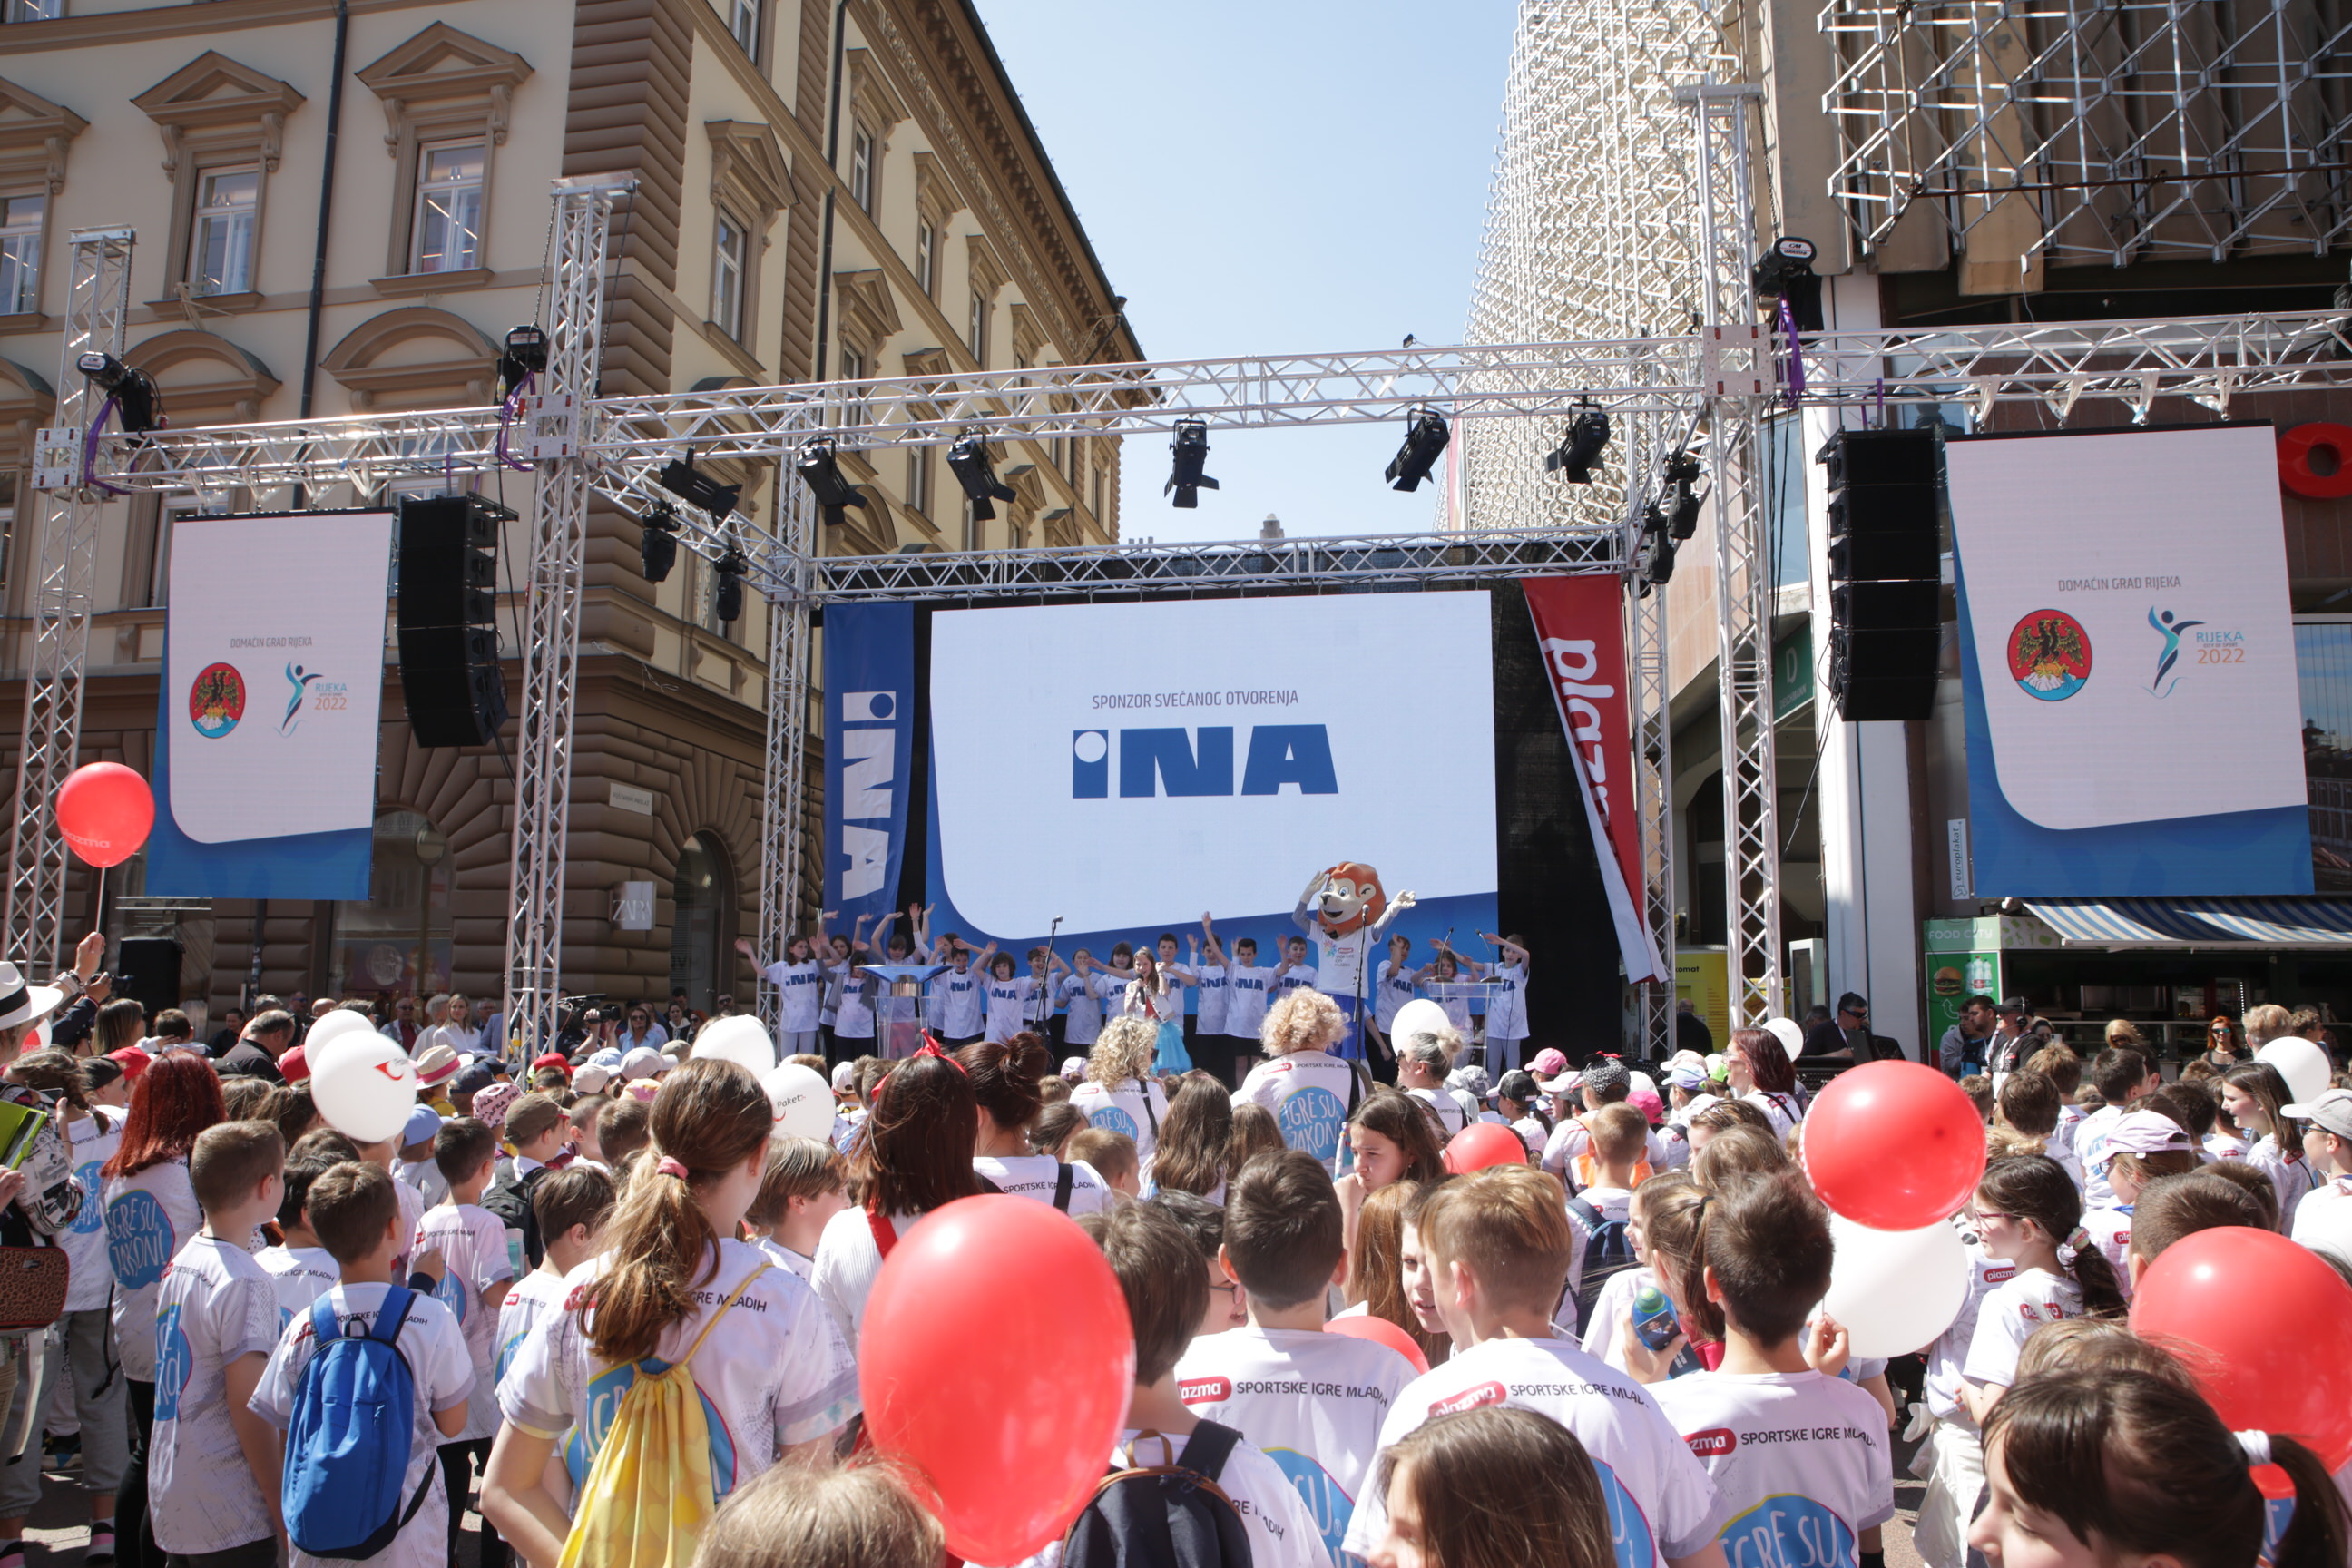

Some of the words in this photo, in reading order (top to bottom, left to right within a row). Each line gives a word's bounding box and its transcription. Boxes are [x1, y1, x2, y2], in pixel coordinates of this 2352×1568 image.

[2058, 576, 2110, 592] DOMAĆIN
[2112, 576, 2142, 591] GRAD
[2144, 575, 2181, 591] RIJEKA
[266, 637, 287, 648] GRAD
[288, 636, 313, 648] RIJEKA
[2196, 631, 2246, 643] RIJEKA
[2196, 647, 2246, 664] 2022
[315, 682, 348, 692] RIJEKA
[314, 697, 348, 710] 2022
[1092, 692, 1152, 710] SPONZOR
[1154, 687, 1222, 709] SVEČANOG
[1225, 690, 1299, 708] OTVORENJA
[1952, 827, 1963, 882] europlakat
[612, 899, 652, 922] ZARA
[1928, 929, 1961, 940] FOOD
[1283, 1092, 1317, 1131] IGRE
[1318, 1094, 1337, 1117] SU
[1003, 1182, 1046, 1193] SPORTSKE
[307, 1270, 336, 1282] MLADIH
[1987, 1269, 2015, 1282] plazm
[404, 1316, 428, 1327] LADIH
[1237, 1380, 1308, 1395] SPORTSKE
[1312, 1382, 1342, 1397] IGRE
[1347, 1386, 1388, 1408] MLADIH
[1510, 1383, 1577, 1396] SPORTSKE
[1581, 1383, 1610, 1396] IGRE
[1740, 1428, 1808, 1446] SPORTSKE
[1812, 1427, 1840, 1440] IGRE
[1798, 1514, 1838, 1568] SU
